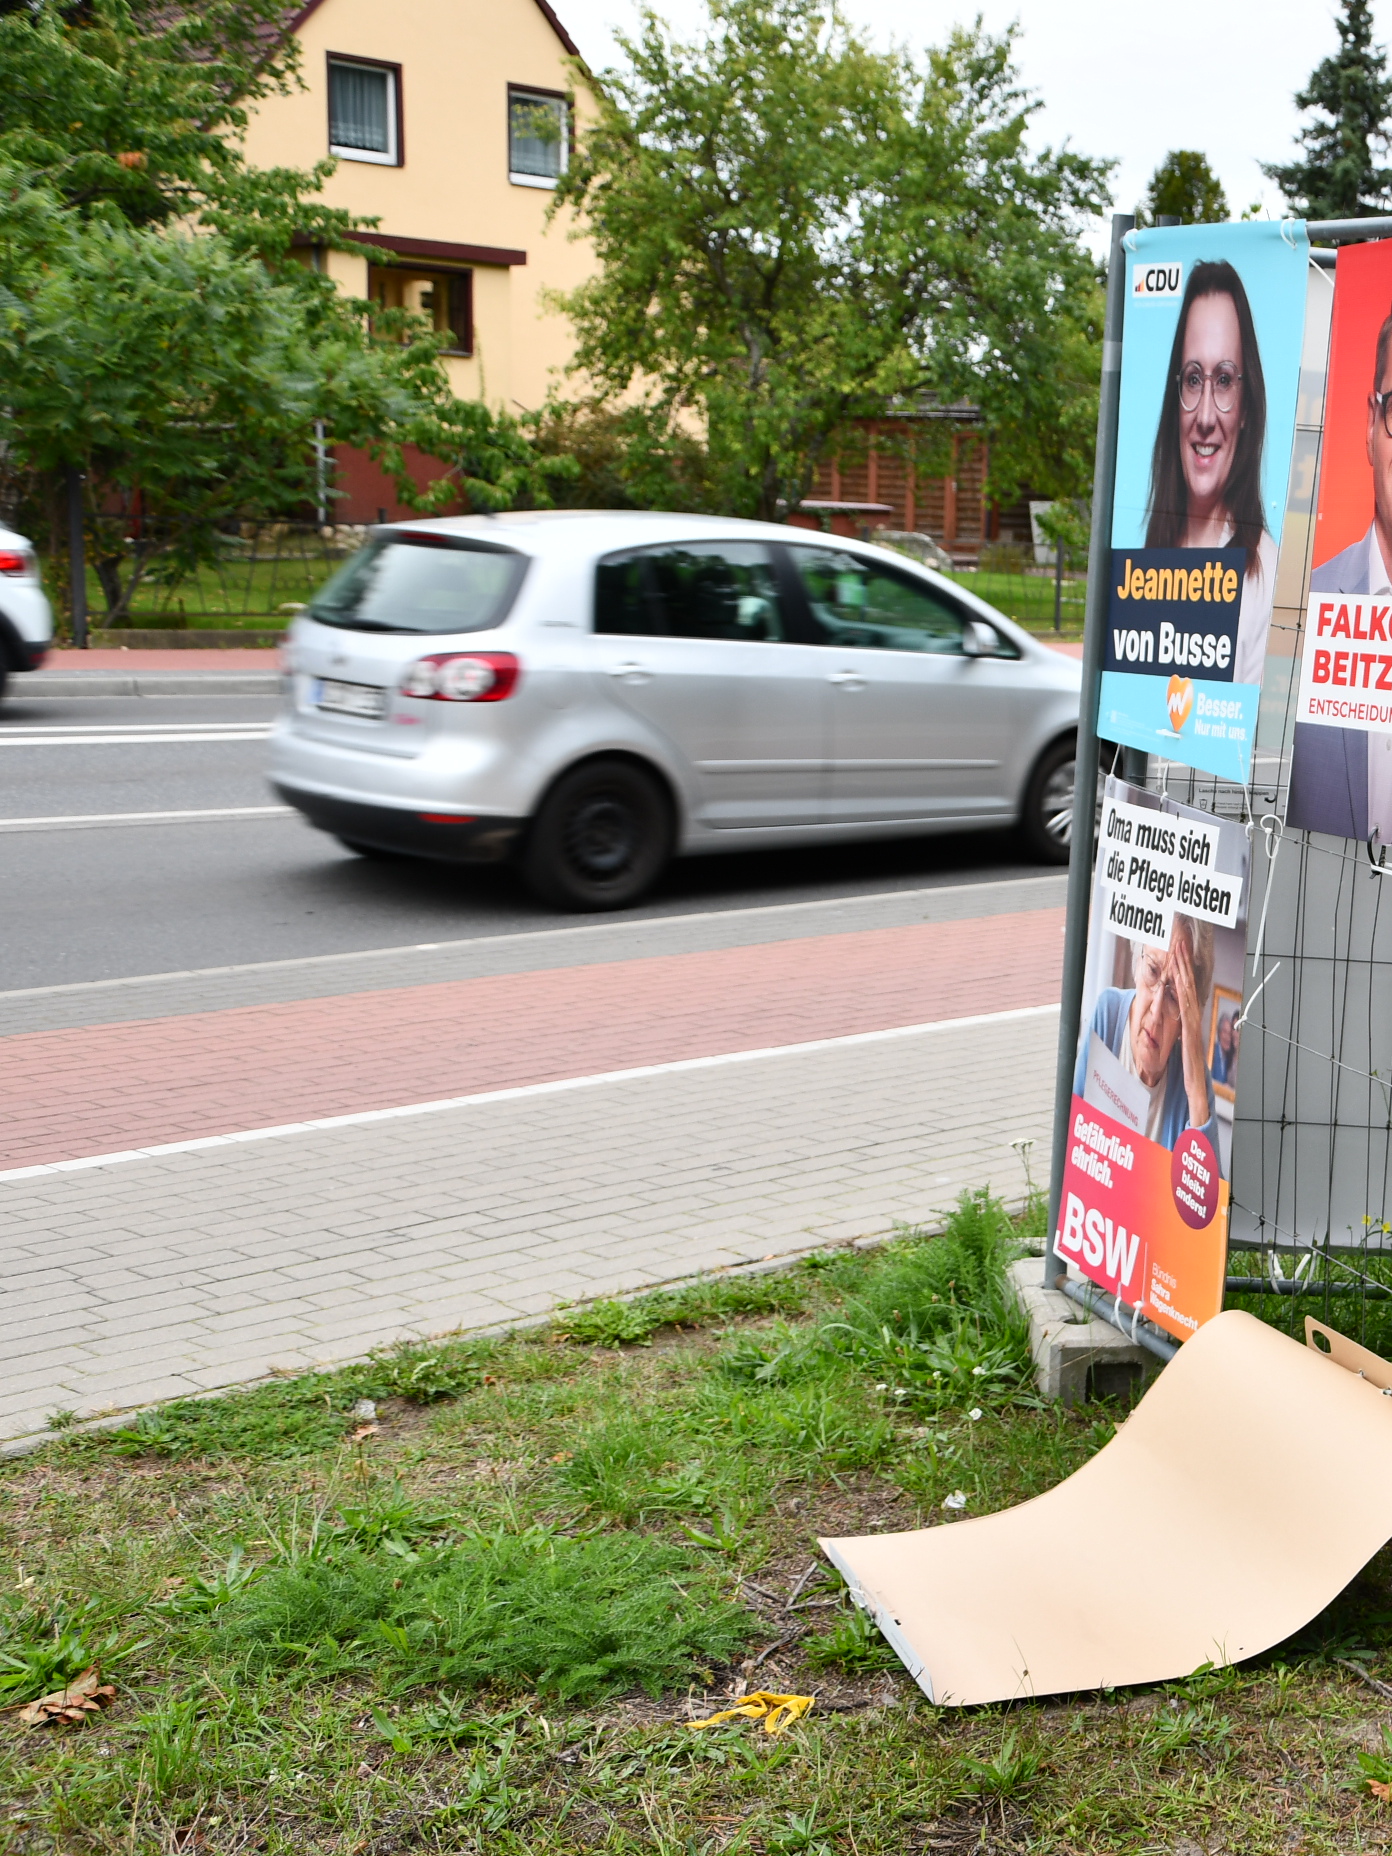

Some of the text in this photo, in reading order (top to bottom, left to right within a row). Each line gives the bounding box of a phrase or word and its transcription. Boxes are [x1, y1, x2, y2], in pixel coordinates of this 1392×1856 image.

[1145, 268, 1180, 292] CDU
[1117, 558, 1238, 603] Jeannette
[1113, 621, 1232, 669] von Busse
[1196, 692, 1243, 720] Besser.
[1194, 719, 1247, 741] Nur mit uns.
[1106, 807, 1211, 866] Oma muss sich
[1106, 850, 1232, 916] die Pflege leisten
[1109, 891, 1166, 938] können.
[1073, 1113, 1135, 1171] Gefährlich
[1190, 1139, 1207, 1162] Der
[1071, 1145, 1114, 1189] ehrlich.
[1181, 1151, 1211, 1185] OSTEN
[1181, 1169, 1206, 1200] bleibt
[1175, 1186, 1207, 1219] anders!
[1061, 1191, 1141, 1288] BSW
[1150, 1278, 1171, 1302] Sahra
[1152, 1262, 1177, 1289] Bündnis
[1149, 1290, 1199, 1332] Wagenknecht
